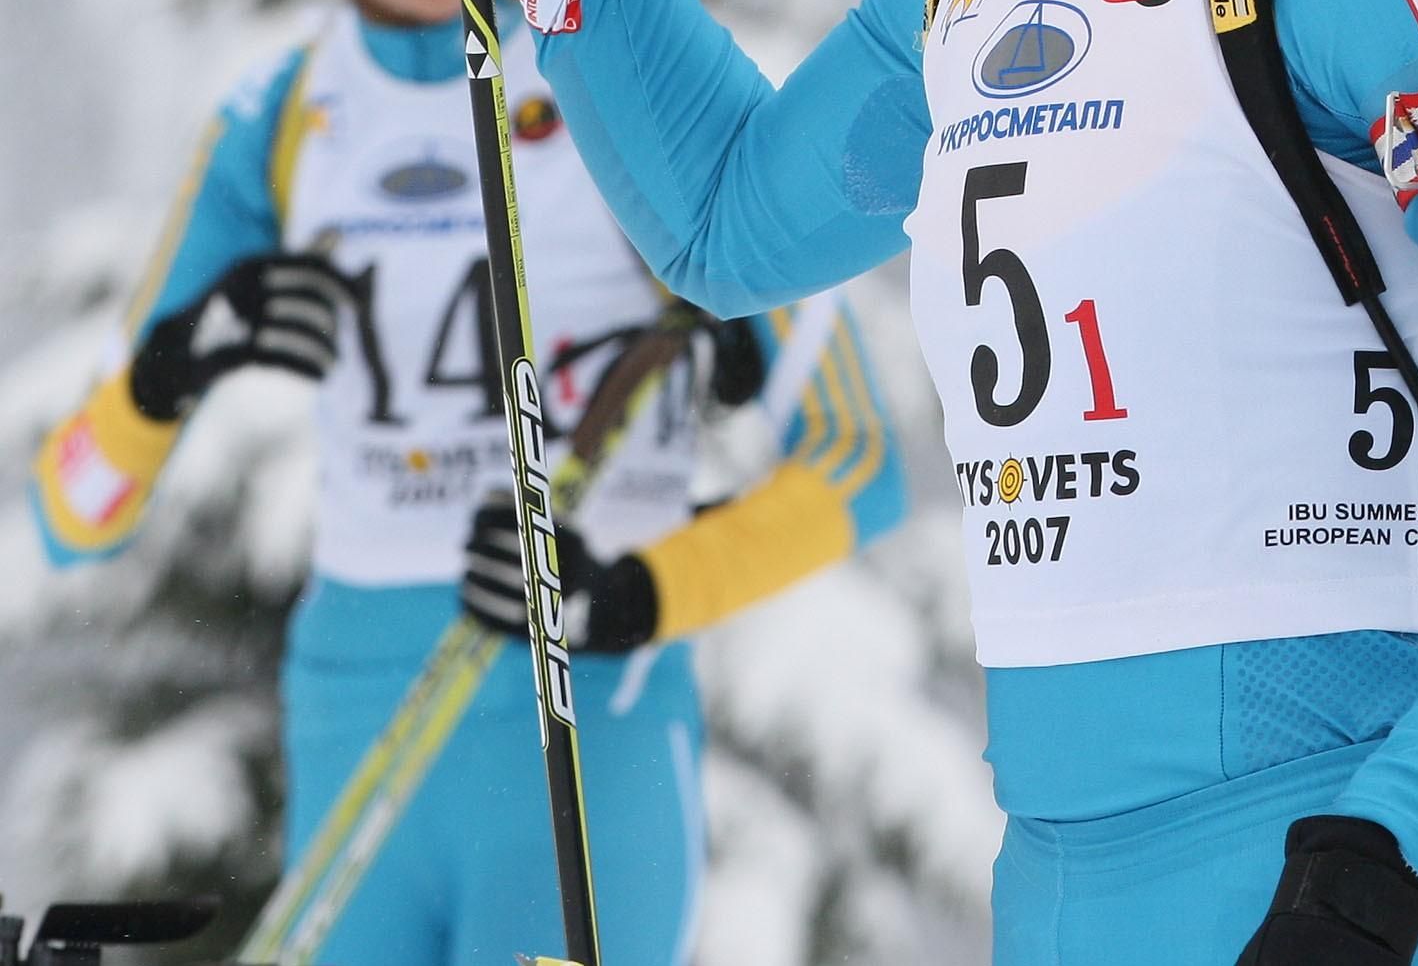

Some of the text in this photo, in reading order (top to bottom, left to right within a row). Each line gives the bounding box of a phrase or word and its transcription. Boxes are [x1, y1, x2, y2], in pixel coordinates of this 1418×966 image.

[938, 100, 1124, 155] УКРРОСМЕТАЛЛ
[1288, 503, 1328, 521] IBU
[516, 360, 576, 728] FISCHER
[986, 516, 1070, 565] 2007
[1265, 528, 1391, 546] EUROPEAN
